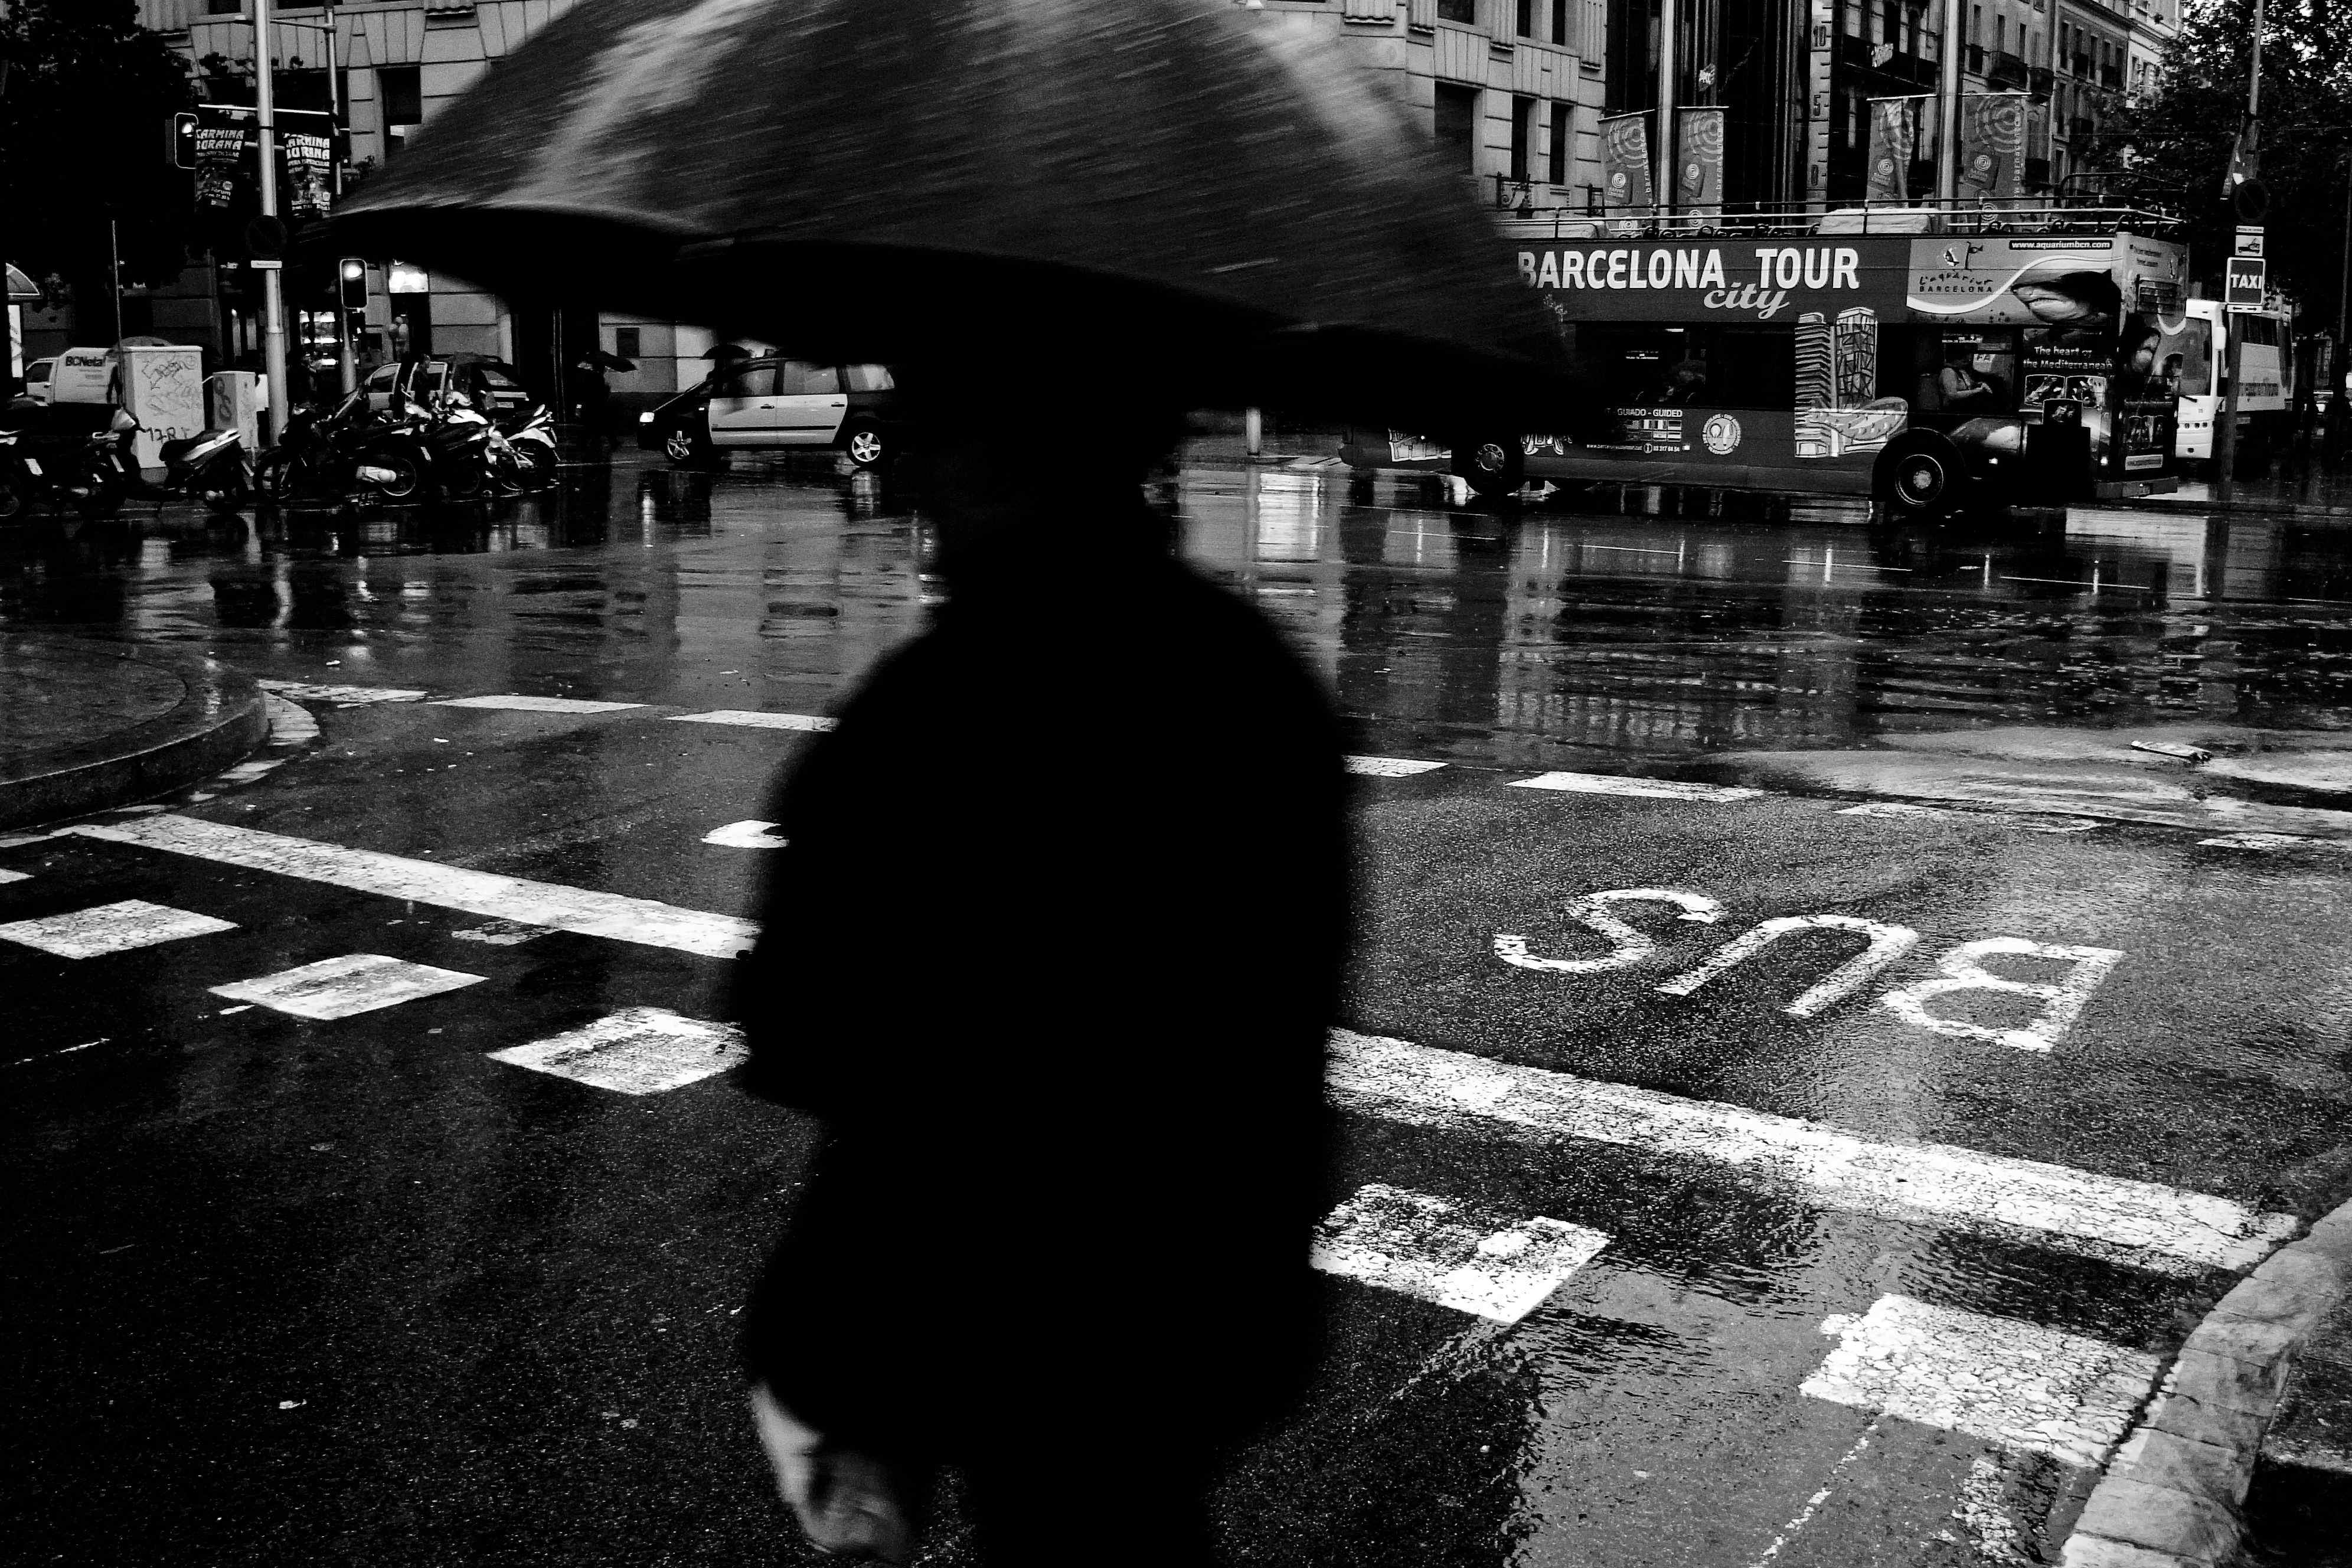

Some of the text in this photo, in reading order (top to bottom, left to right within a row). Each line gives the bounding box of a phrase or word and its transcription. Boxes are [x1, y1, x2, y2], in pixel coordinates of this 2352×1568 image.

[2011, 240, 2110, 250] www.aquariumbcn.com
[1518, 248, 1860, 289] BARCELONA TOUR
[2230, 274, 2262, 289] TAXI
[1704, 282, 1790, 319] city
[2034, 345, 2052, 355] The
[2054, 346, 2079, 355] heart
[2023, 358, 2037, 368] the
[1653, 409, 1683, 417] GUIDED
[1492, 888, 2125, 1052] BUS
